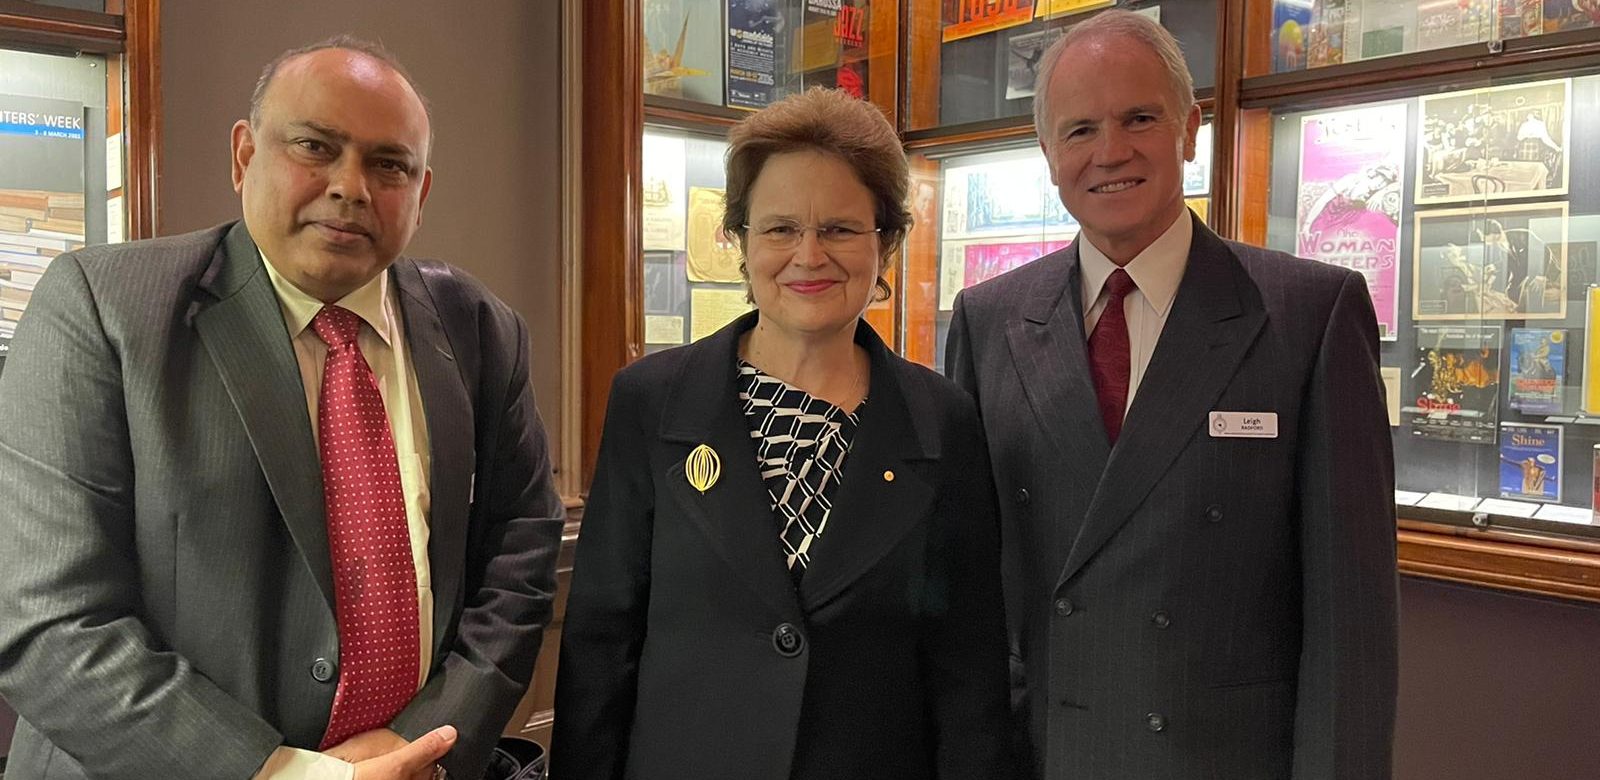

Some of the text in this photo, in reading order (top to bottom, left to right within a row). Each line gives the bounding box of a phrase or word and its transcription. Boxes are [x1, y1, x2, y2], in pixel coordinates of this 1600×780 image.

[832, 5, 864, 41] JAZZ
[43, 114, 81, 130] WEEK
[48, 130, 67, 138] MARCH
[1300, 231, 1396, 255] WOMAN
[1416, 397, 1461, 414] Shine
[1512, 434, 1545, 447] Shine
